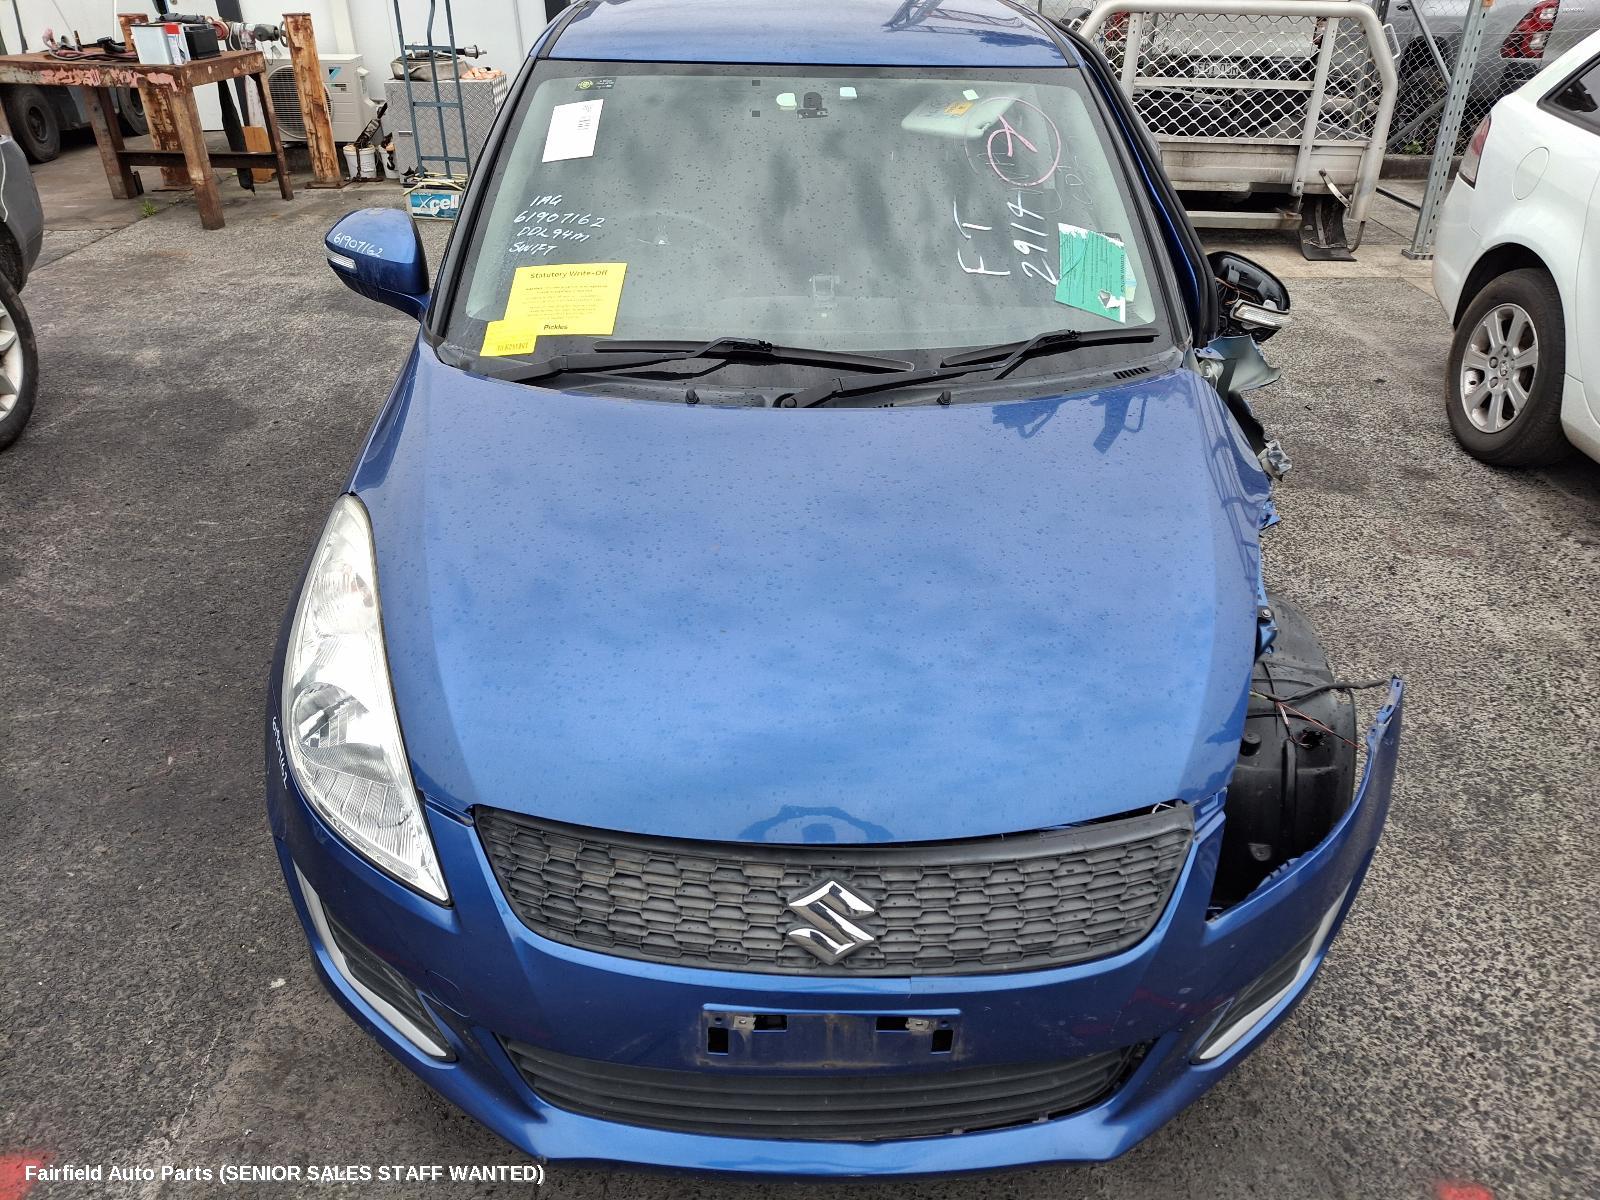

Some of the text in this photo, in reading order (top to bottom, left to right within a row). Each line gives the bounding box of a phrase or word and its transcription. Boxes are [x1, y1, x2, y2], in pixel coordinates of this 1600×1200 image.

[513, 210, 605, 228] 61907162
[333, 232, 384, 258] 61907162
[508, 241, 558, 256] SWIFT
[530, 271, 568, 280] Statutory
